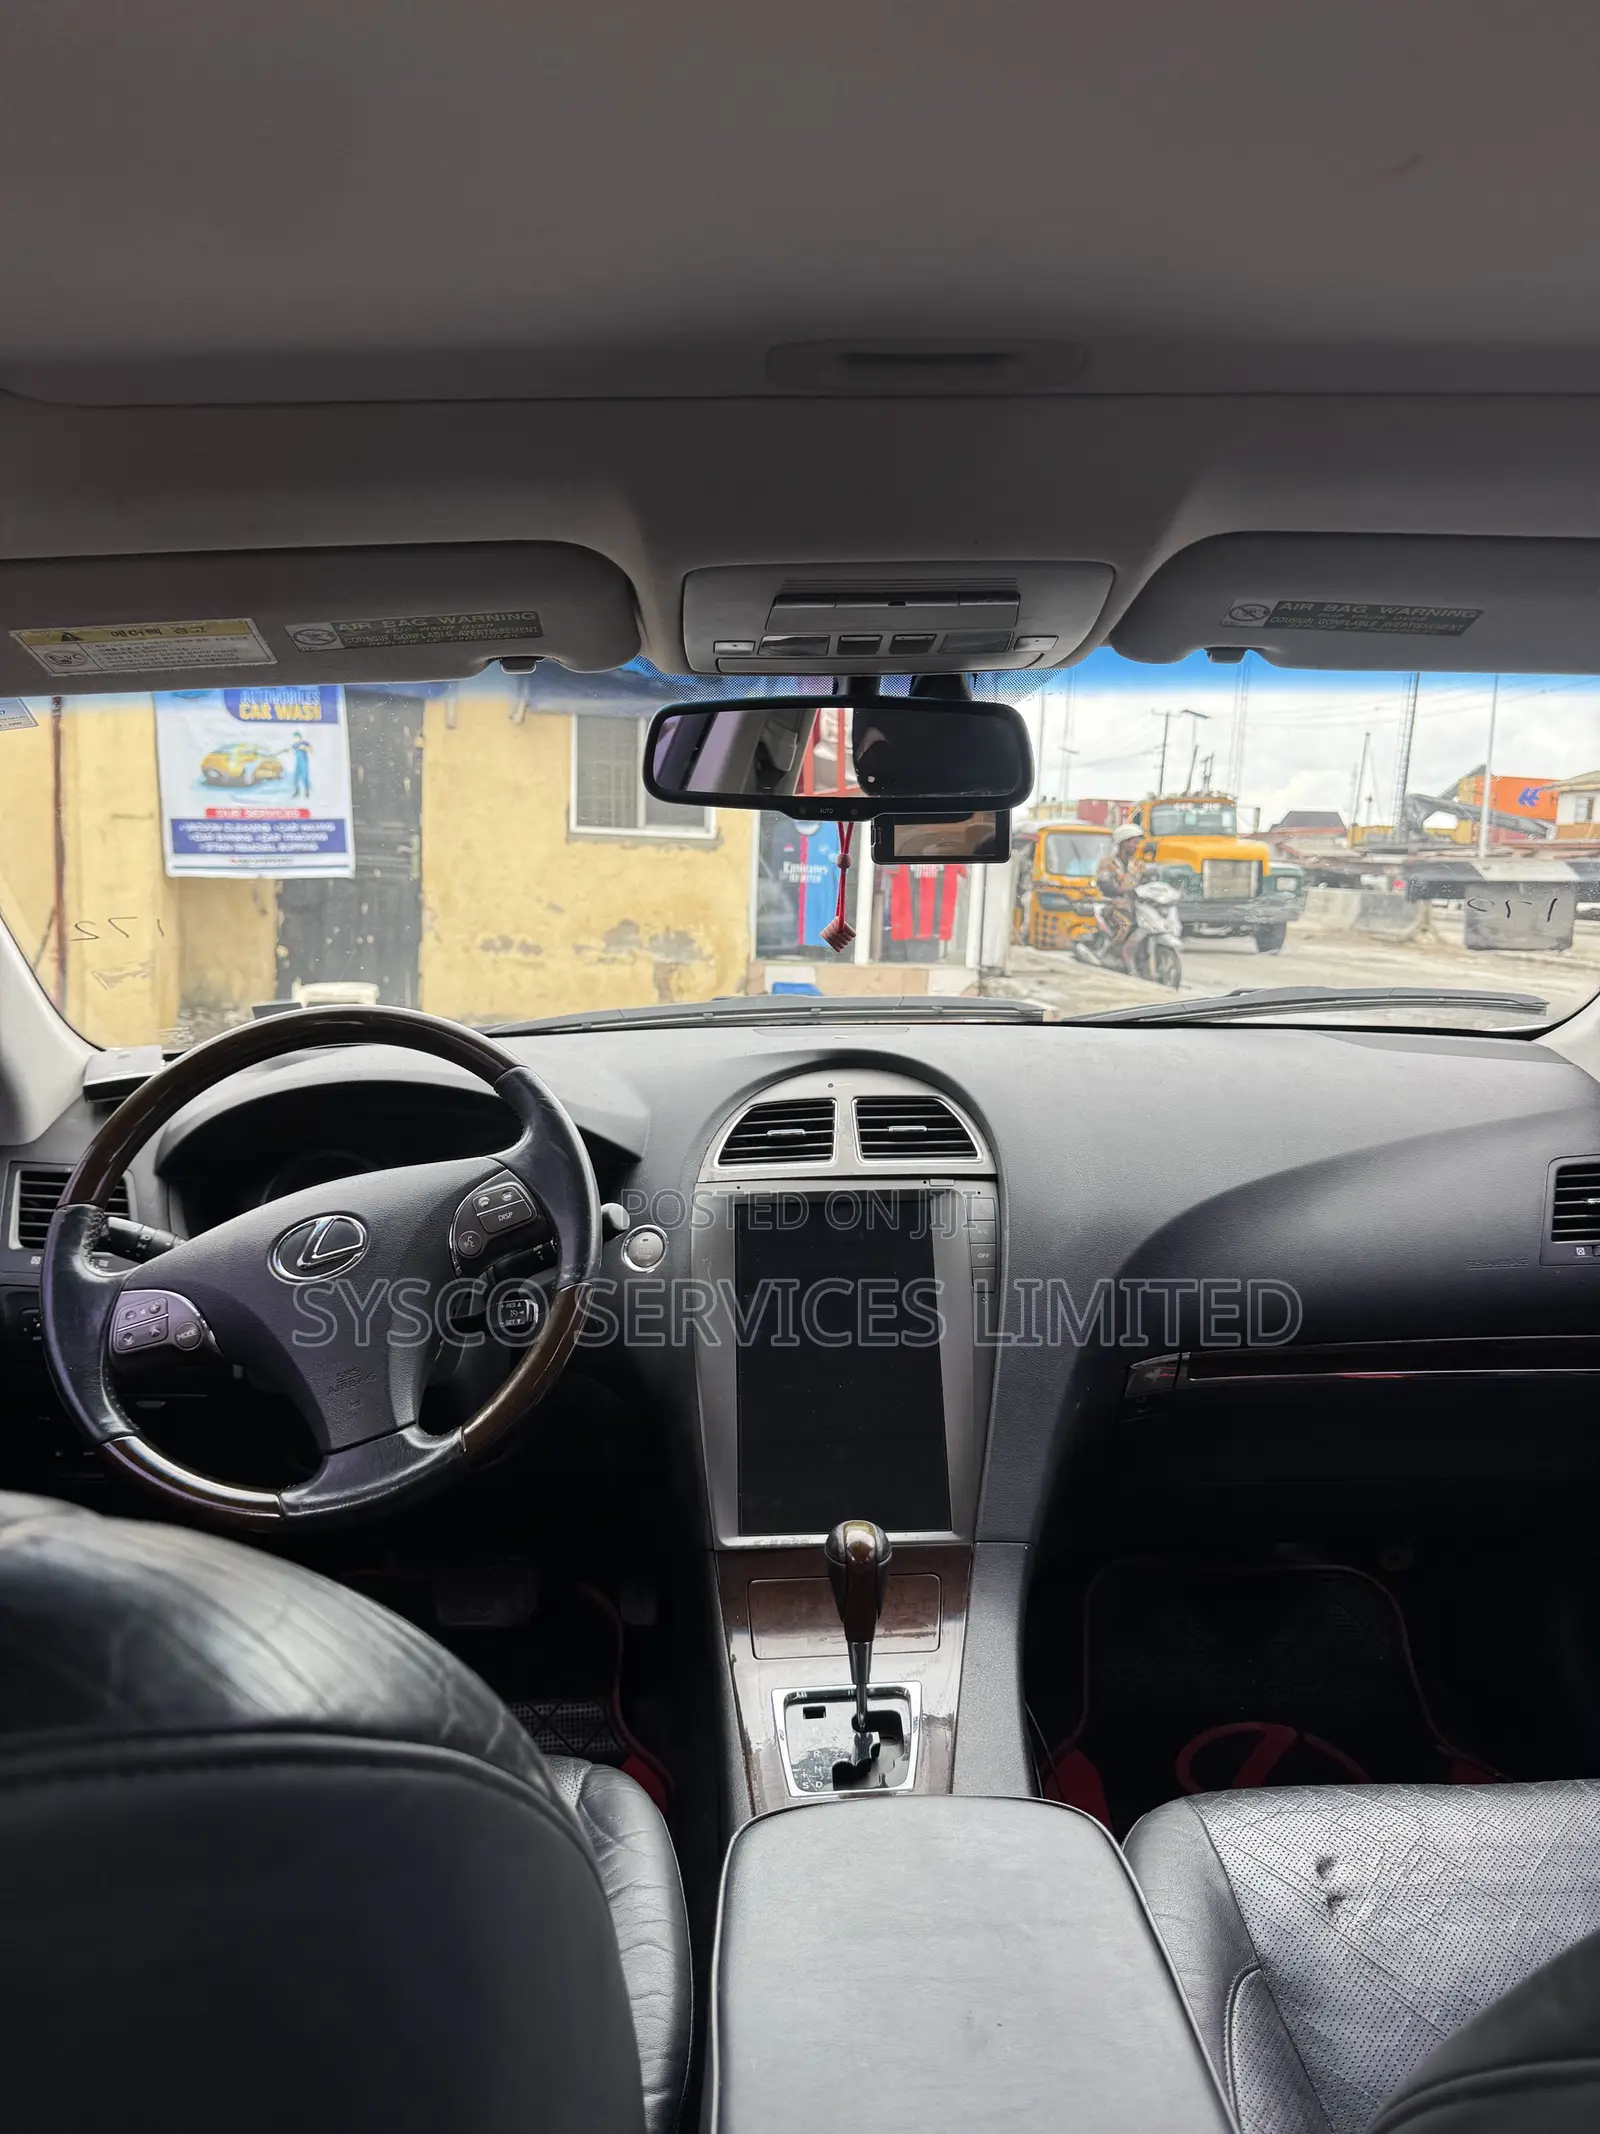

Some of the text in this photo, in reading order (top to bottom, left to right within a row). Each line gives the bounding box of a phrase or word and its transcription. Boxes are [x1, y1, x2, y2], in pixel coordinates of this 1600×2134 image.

[1278, 602, 1478, 619] AIR BAG WARNING
[338, 612, 536, 632] AIR BAG WARNING
[239, 702, 272, 720] CAR
[819, 807, 834, 815] AUTO
[497, 1211, 514, 1222] DISP
[175, 1328, 198, 1341] MODE
